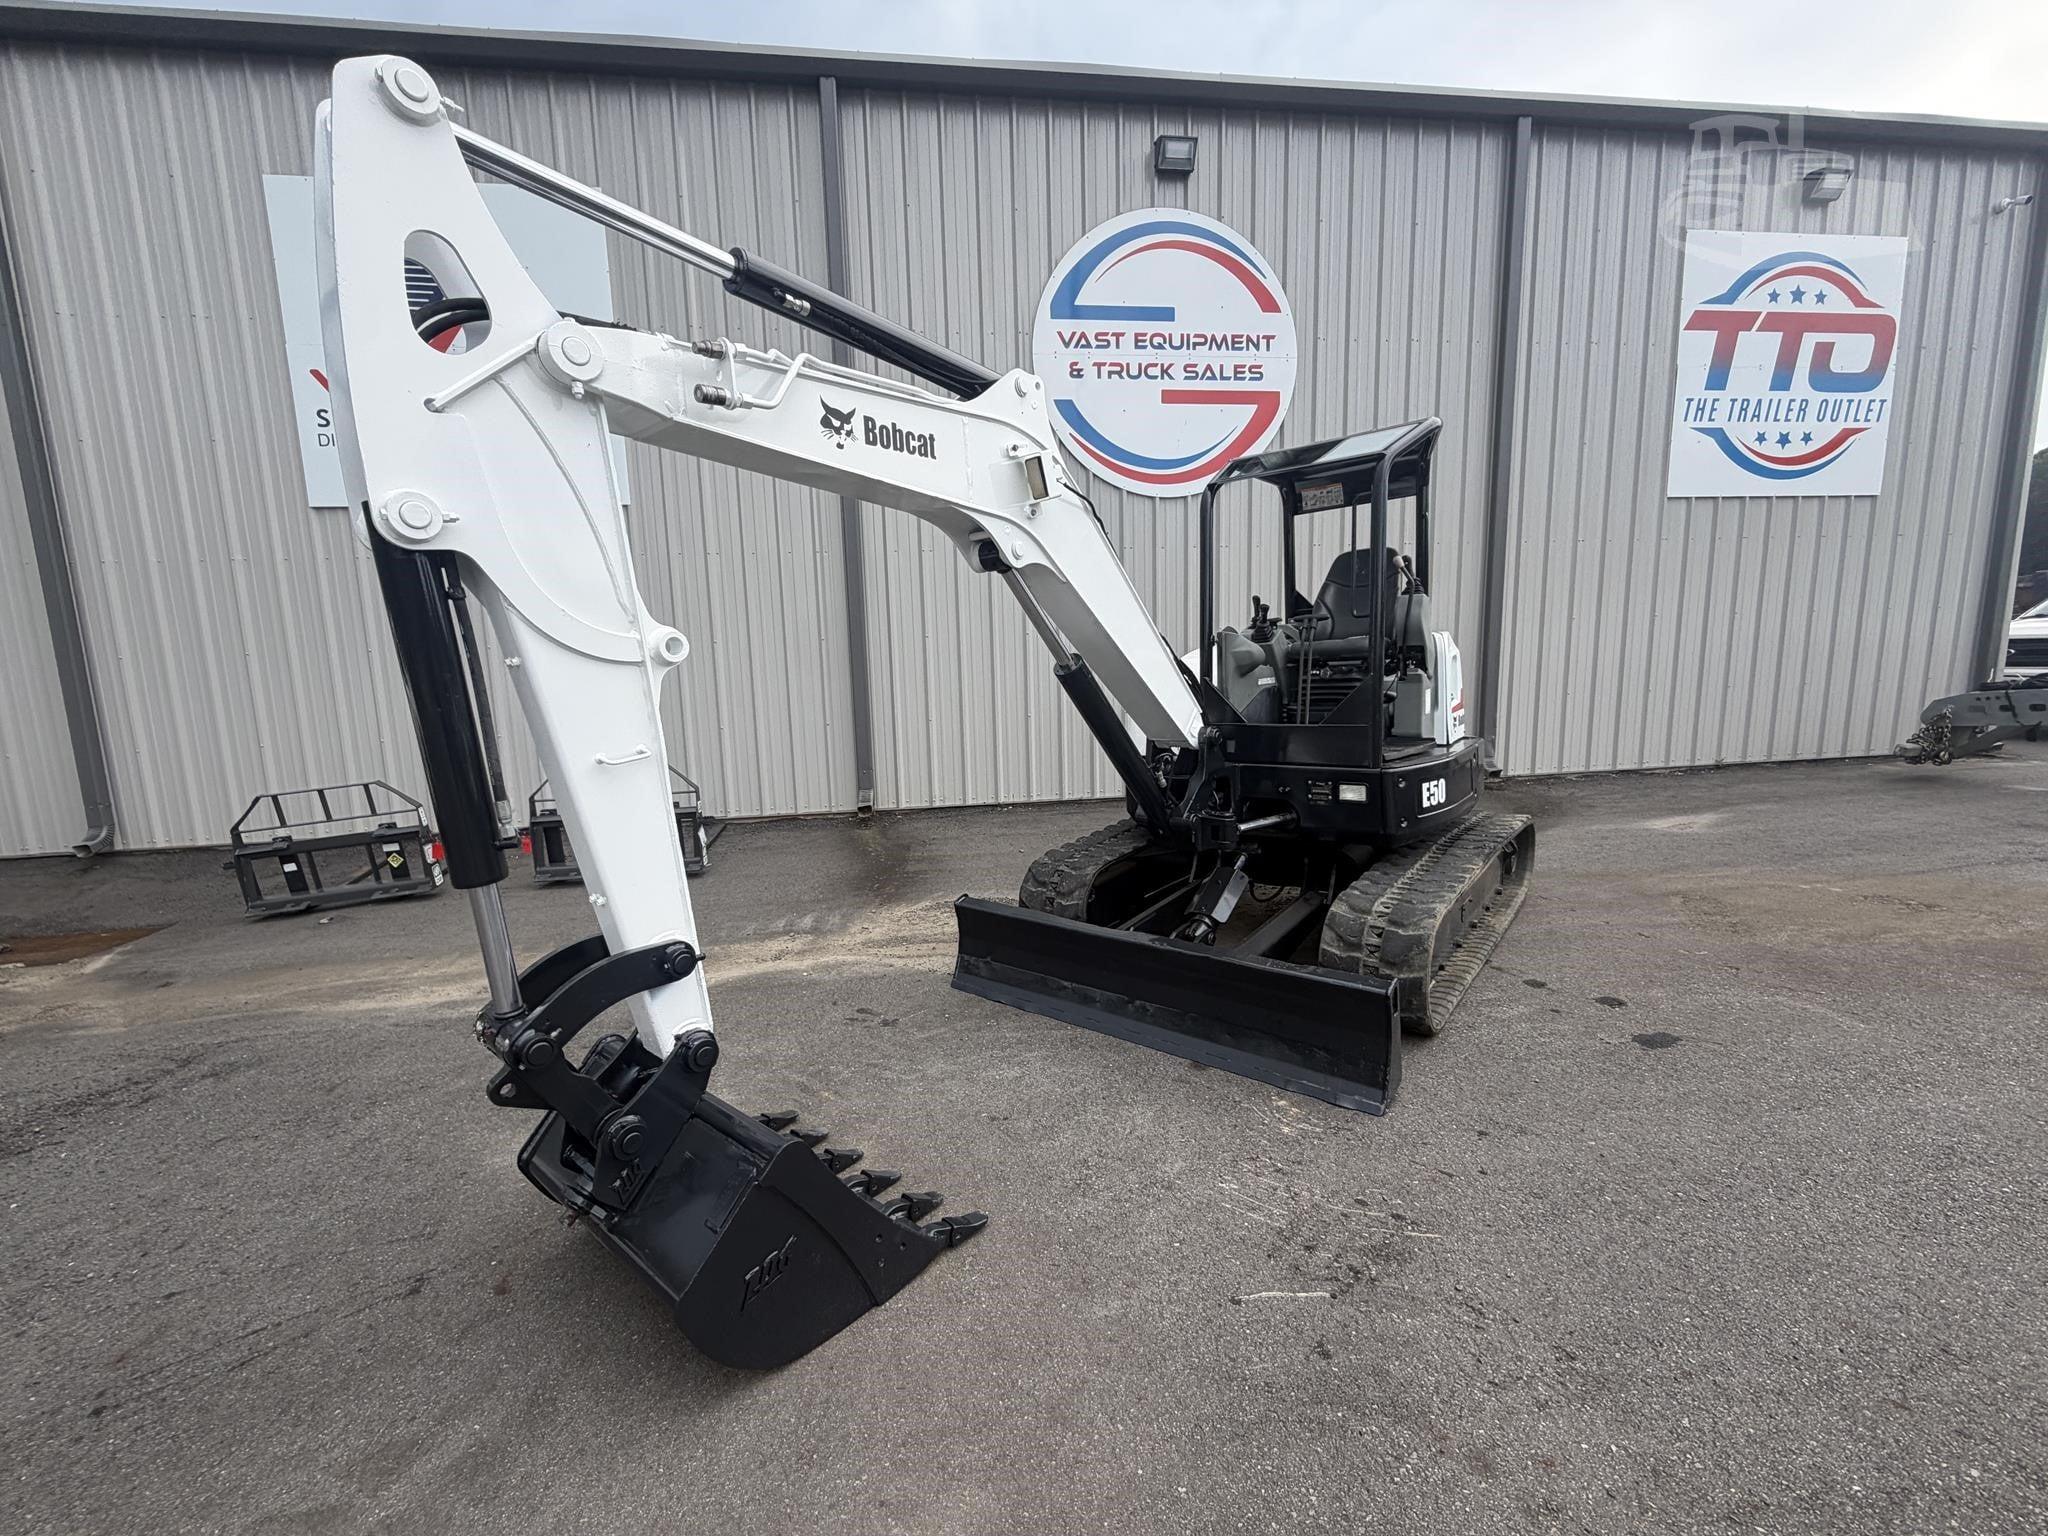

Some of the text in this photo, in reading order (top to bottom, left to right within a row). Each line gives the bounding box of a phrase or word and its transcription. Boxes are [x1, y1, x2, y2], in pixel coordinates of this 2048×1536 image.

[1056, 331, 1277, 352] VAST EQUIPMENT
[1068, 361, 1265, 382] & TRUCK SALES
[1683, 397, 1888, 423] THE TRAILER OUTLET
[863, 414, 937, 460] Bobcat
[1421, 778, 1447, 808] E50
